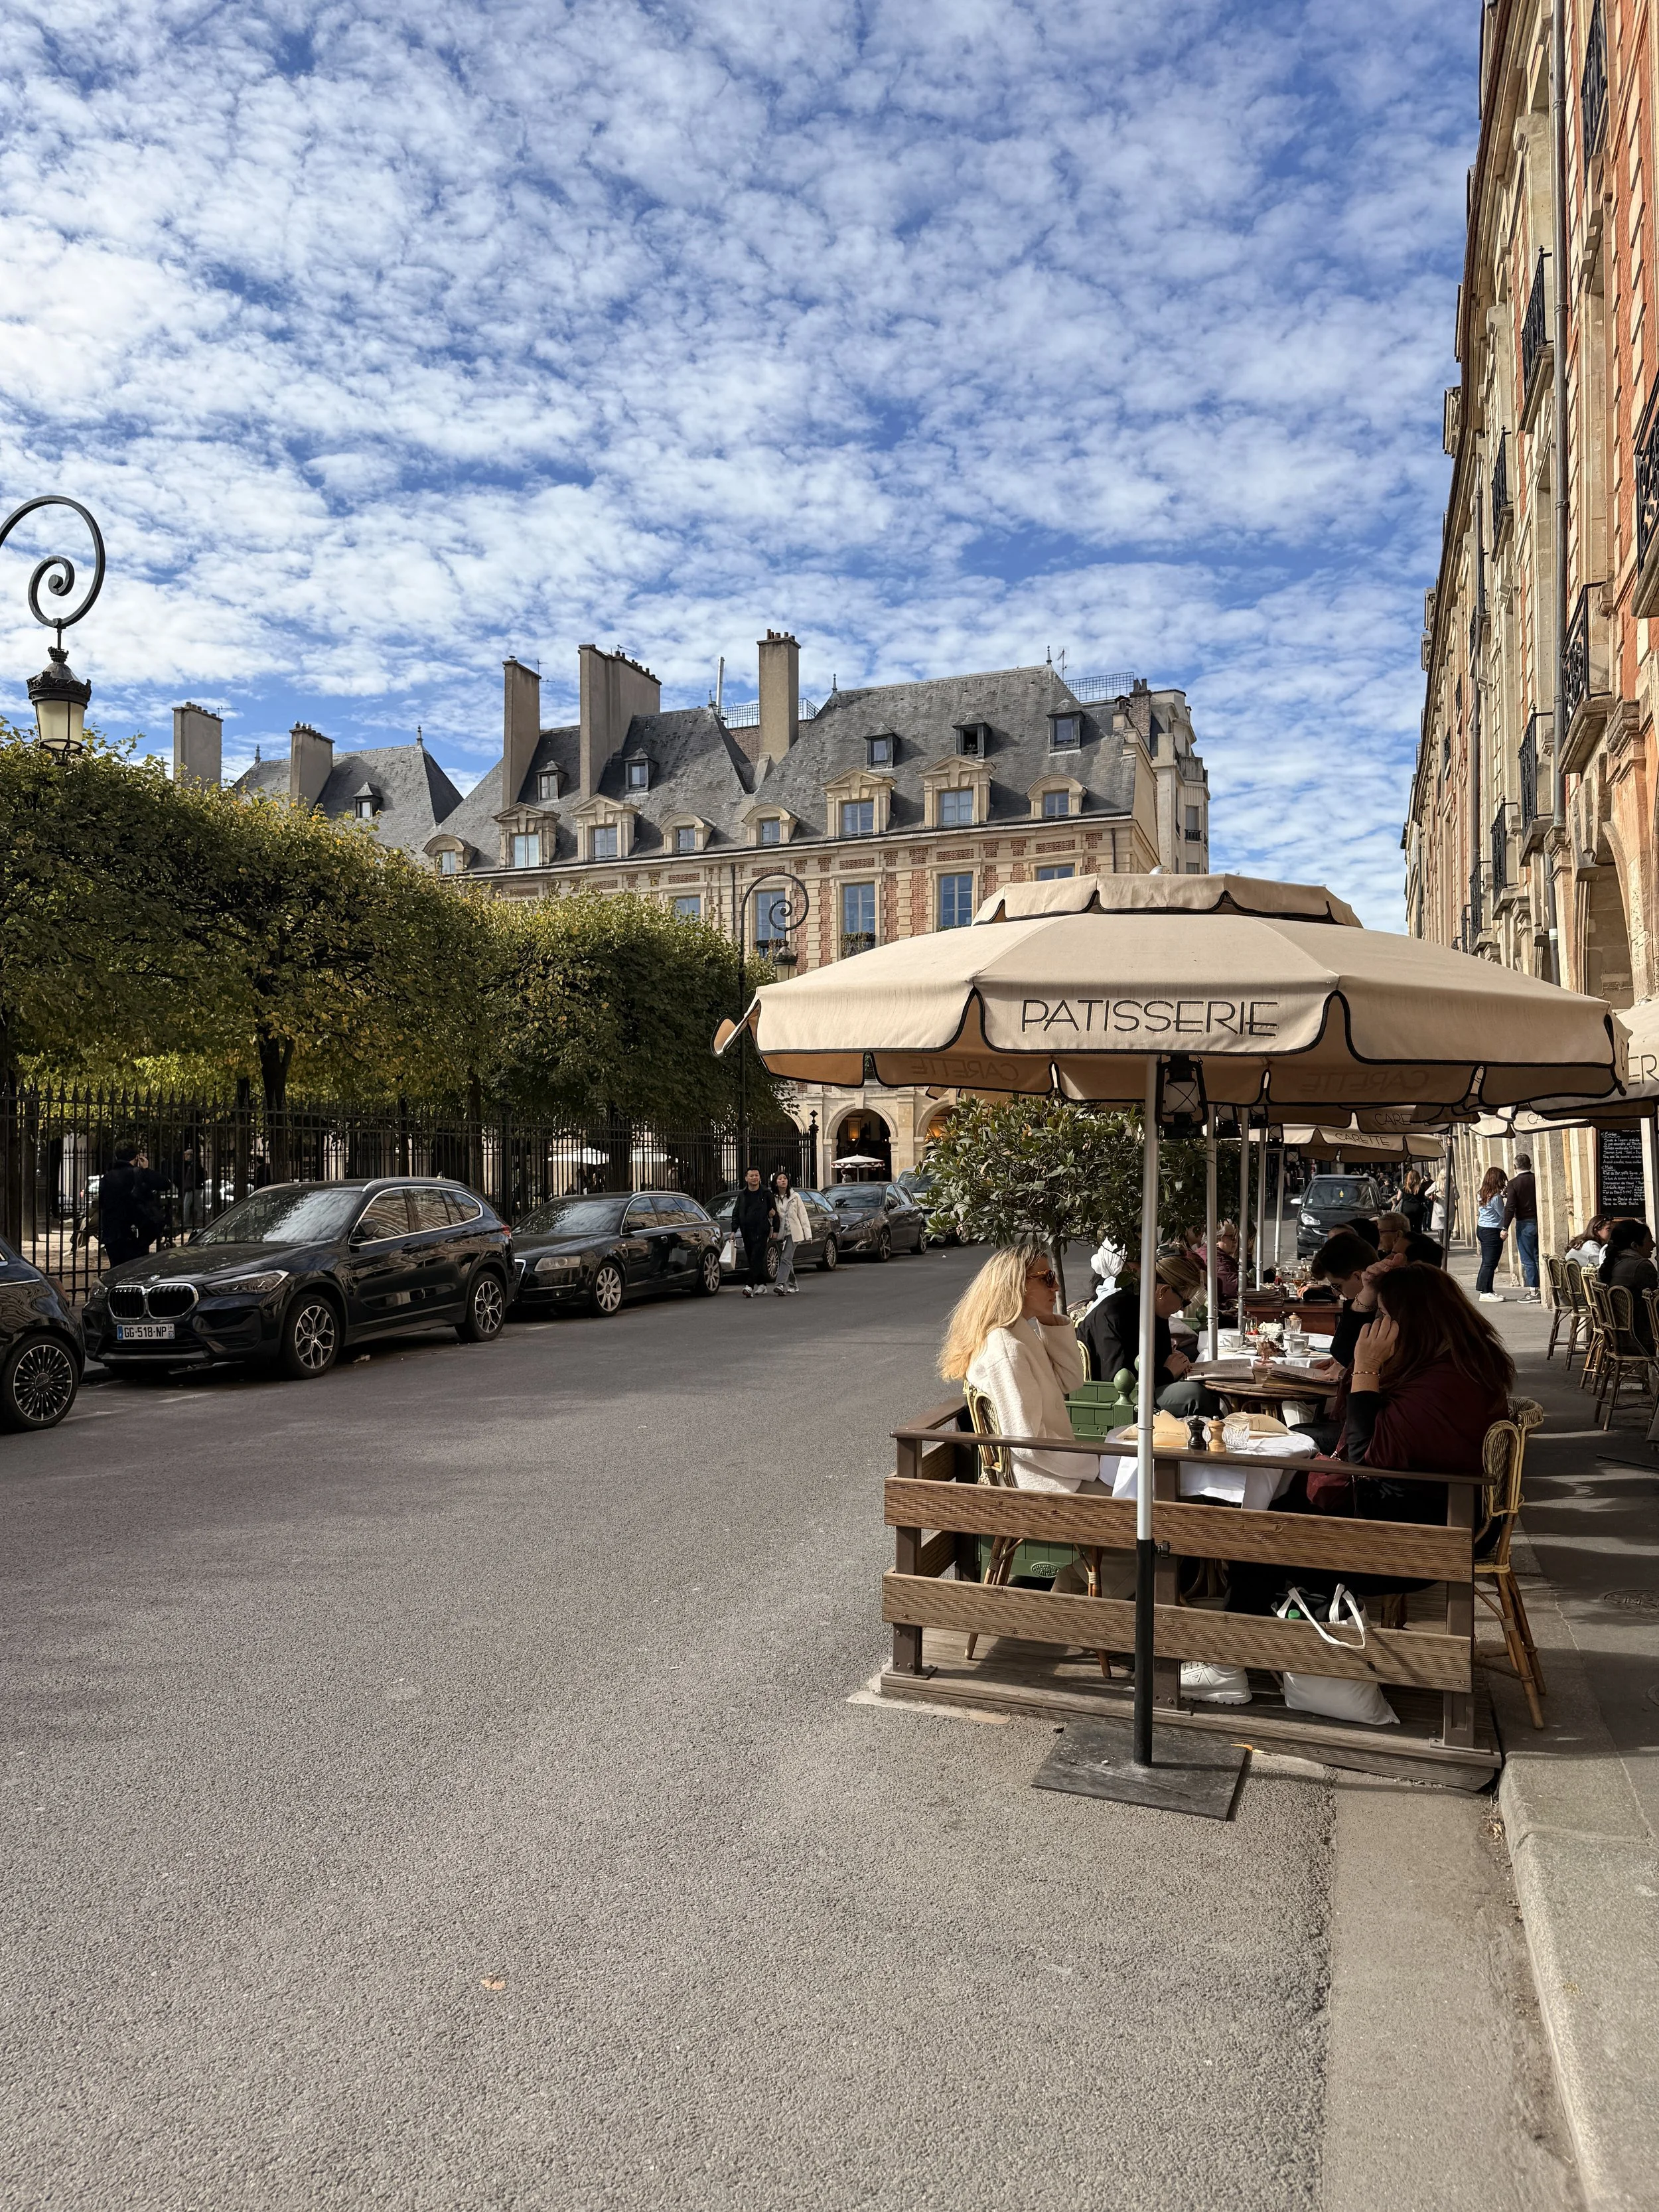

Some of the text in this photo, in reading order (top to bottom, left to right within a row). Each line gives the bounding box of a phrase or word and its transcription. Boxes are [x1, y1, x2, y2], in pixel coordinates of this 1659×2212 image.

[1022, 999, 1279, 1037] PATISSERIE
[1374, 1113, 1413, 1126] CARE
[1334, 1133, 1390, 1146] CARETTE
[123, 1326, 167, 1338] GG-518-NP
